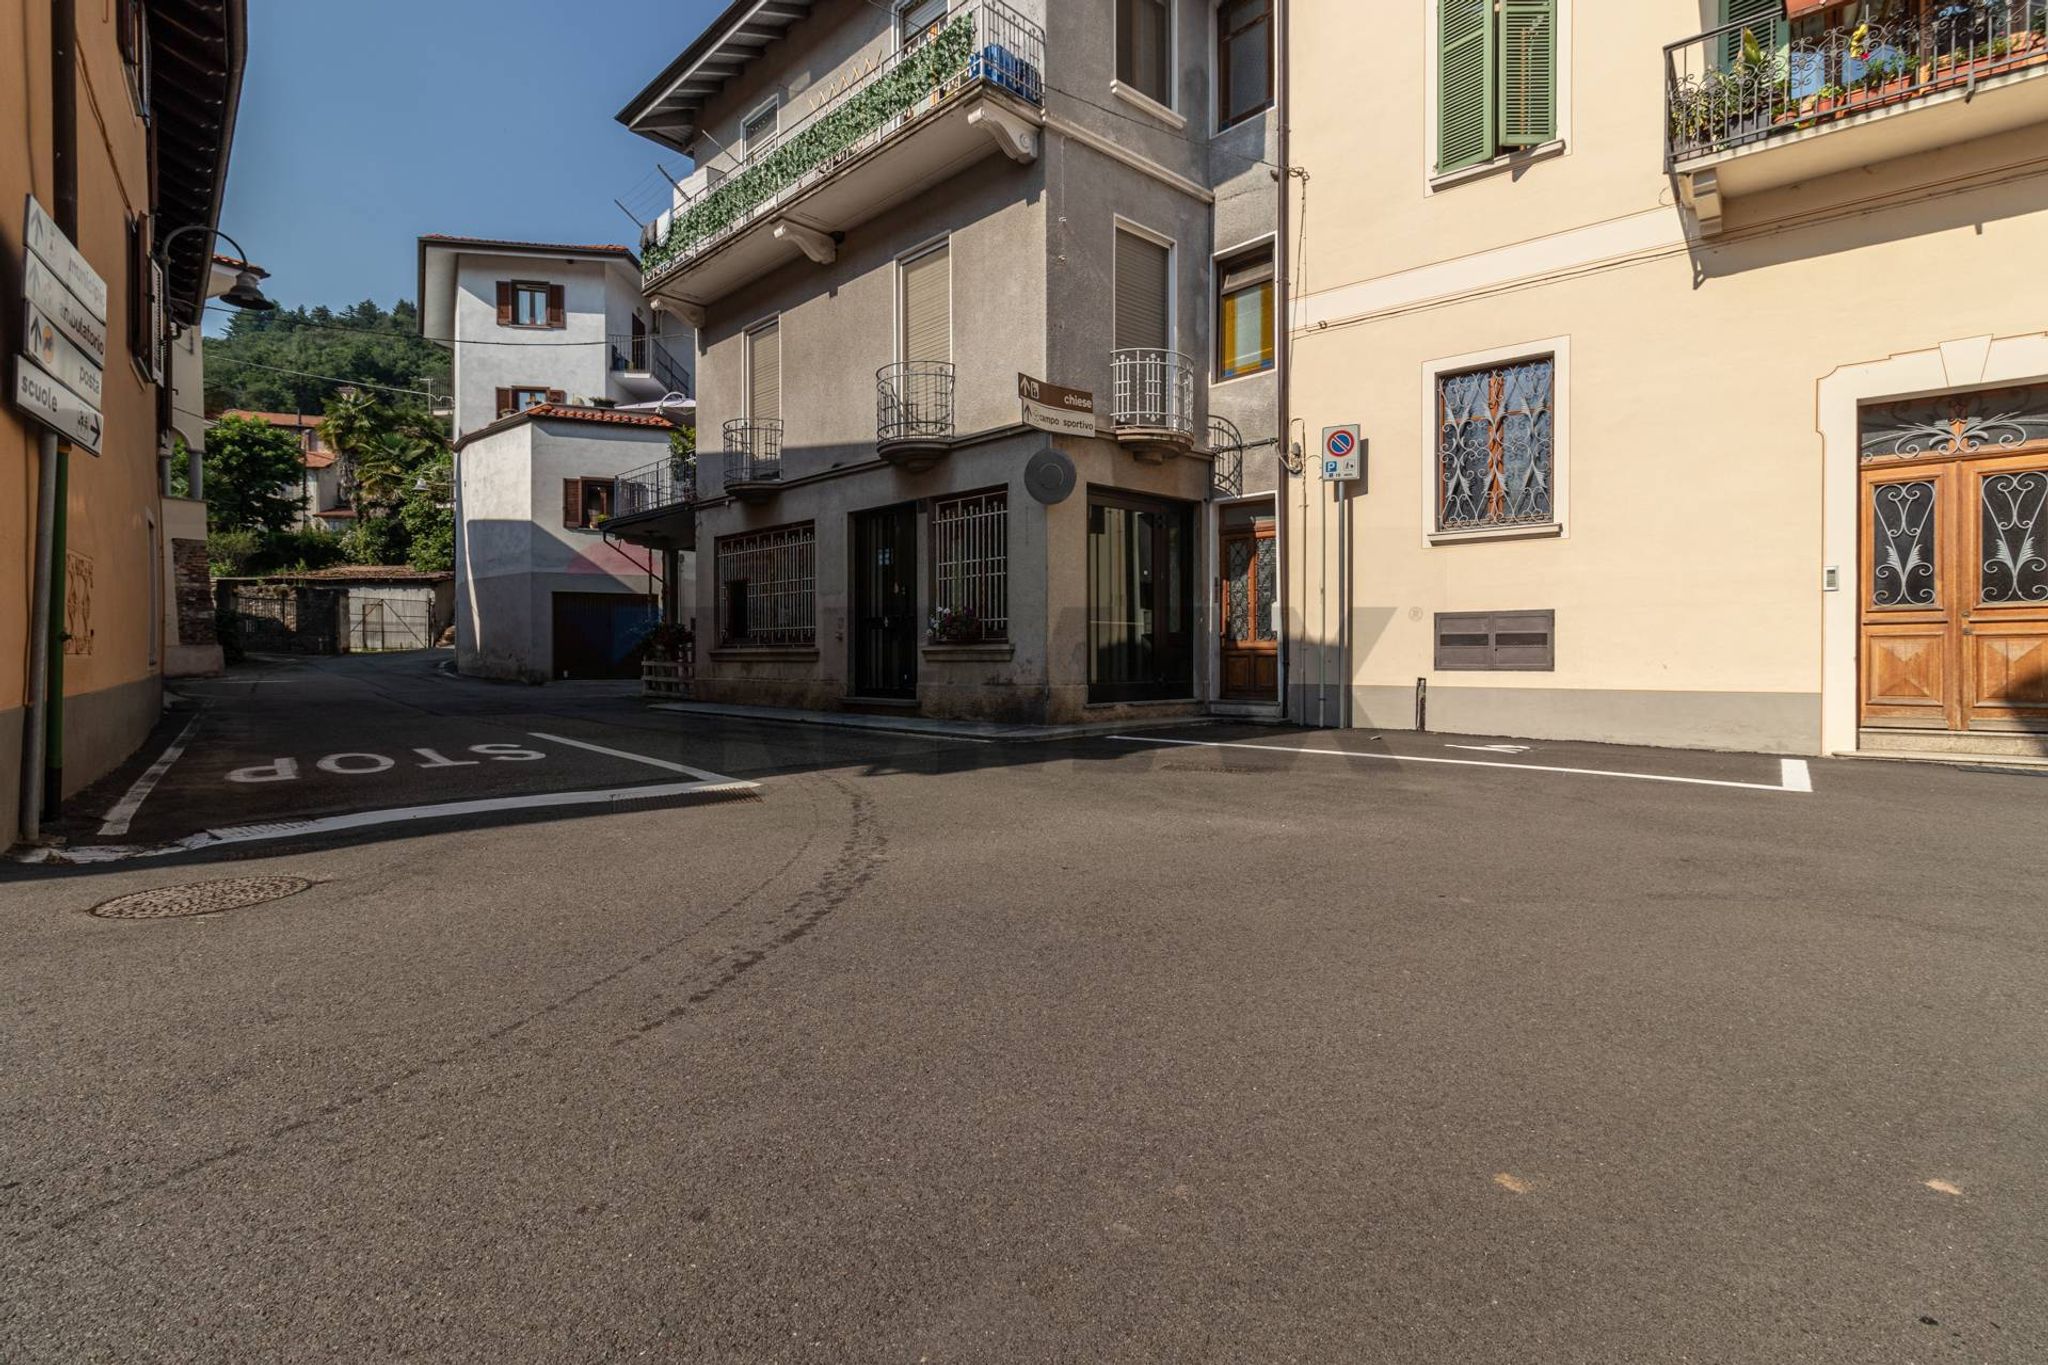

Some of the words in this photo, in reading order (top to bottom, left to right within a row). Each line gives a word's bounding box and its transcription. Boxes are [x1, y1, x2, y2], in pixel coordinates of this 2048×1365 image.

[21, 375, 58, 413] scuole
[1064, 393, 1092, 408] chiese
[1039, 414, 1060, 426] campo
[1063, 419, 1093, 430] sportivo
[224, 743, 547, 783] STOP
